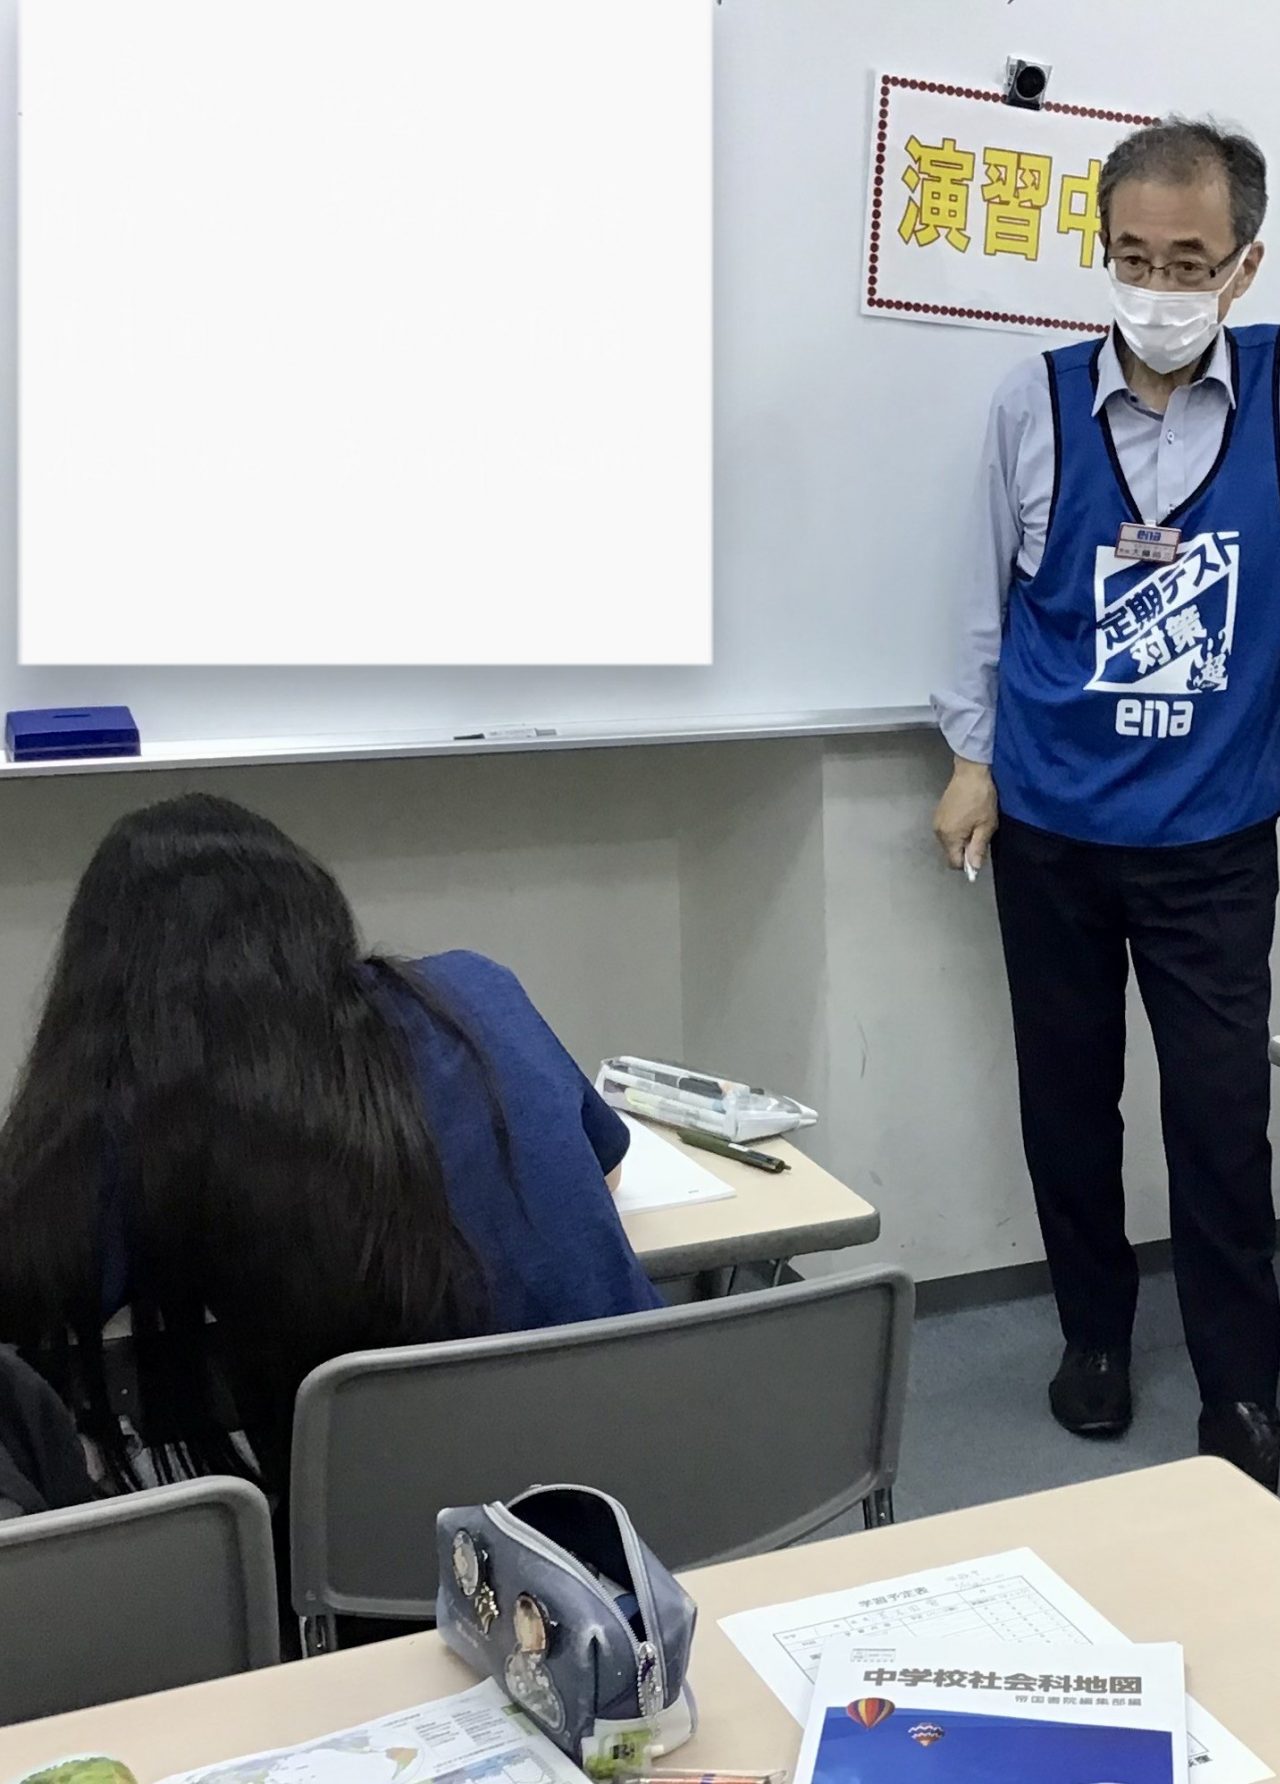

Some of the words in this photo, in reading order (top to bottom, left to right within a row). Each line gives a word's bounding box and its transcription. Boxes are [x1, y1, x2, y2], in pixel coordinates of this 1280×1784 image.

[1137, 530, 1161, 542] ena
[1096, 532, 1239, 650] 定期テスト
[1131, 604, 1207, 674] 対策
[1115, 699, 1194, 739] ena
[858, 1586, 928, 1607] 学習予定表
[863, 1667, 1142, 1694] 中学校社会科地図
